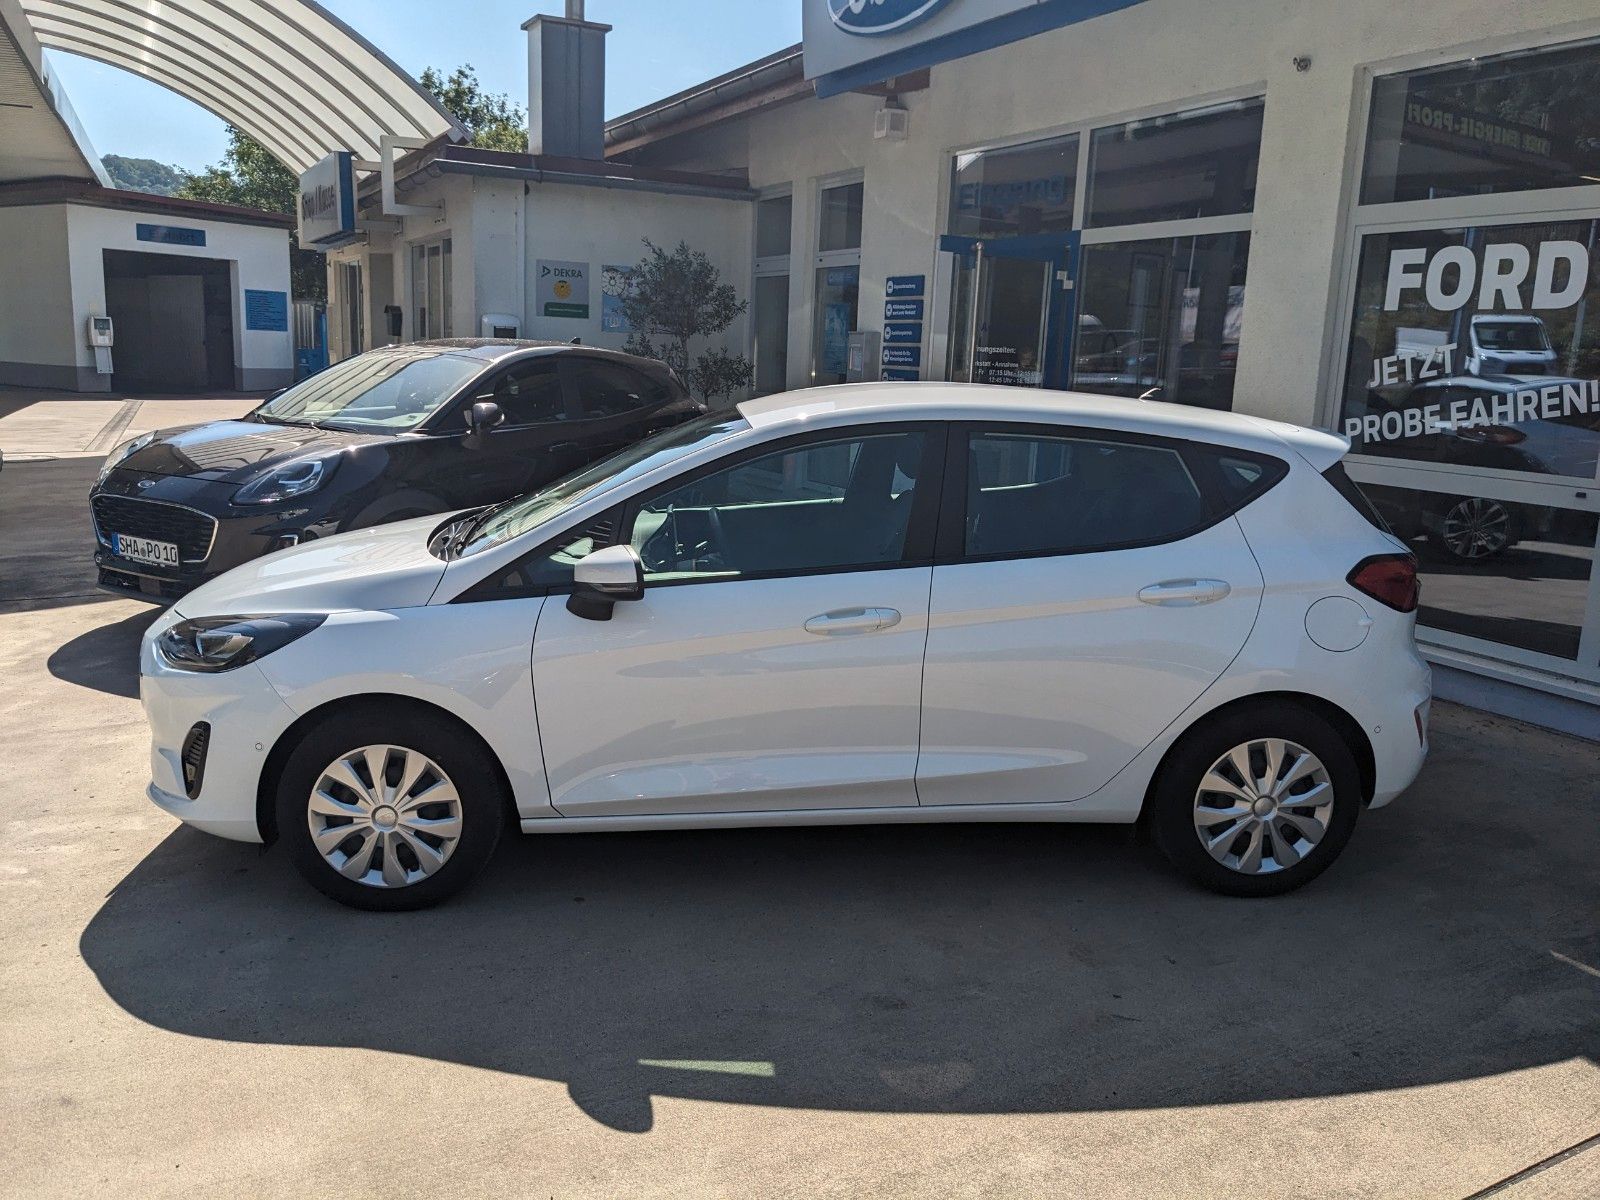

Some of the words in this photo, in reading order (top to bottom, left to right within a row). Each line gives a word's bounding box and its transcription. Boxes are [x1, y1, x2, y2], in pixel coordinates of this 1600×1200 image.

[553, 267, 583, 278] DEKRA
[1384, 240, 1589, 311] FORD
[1369, 343, 1458, 388] JETZT
[1345, 403, 1441, 443] PROBE
[1446, 379, 1600, 431] FAHREN!
[119, 537, 140, 556] SHA
[146, 542, 161, 559] PO
[163, 545, 177, 563] 10
